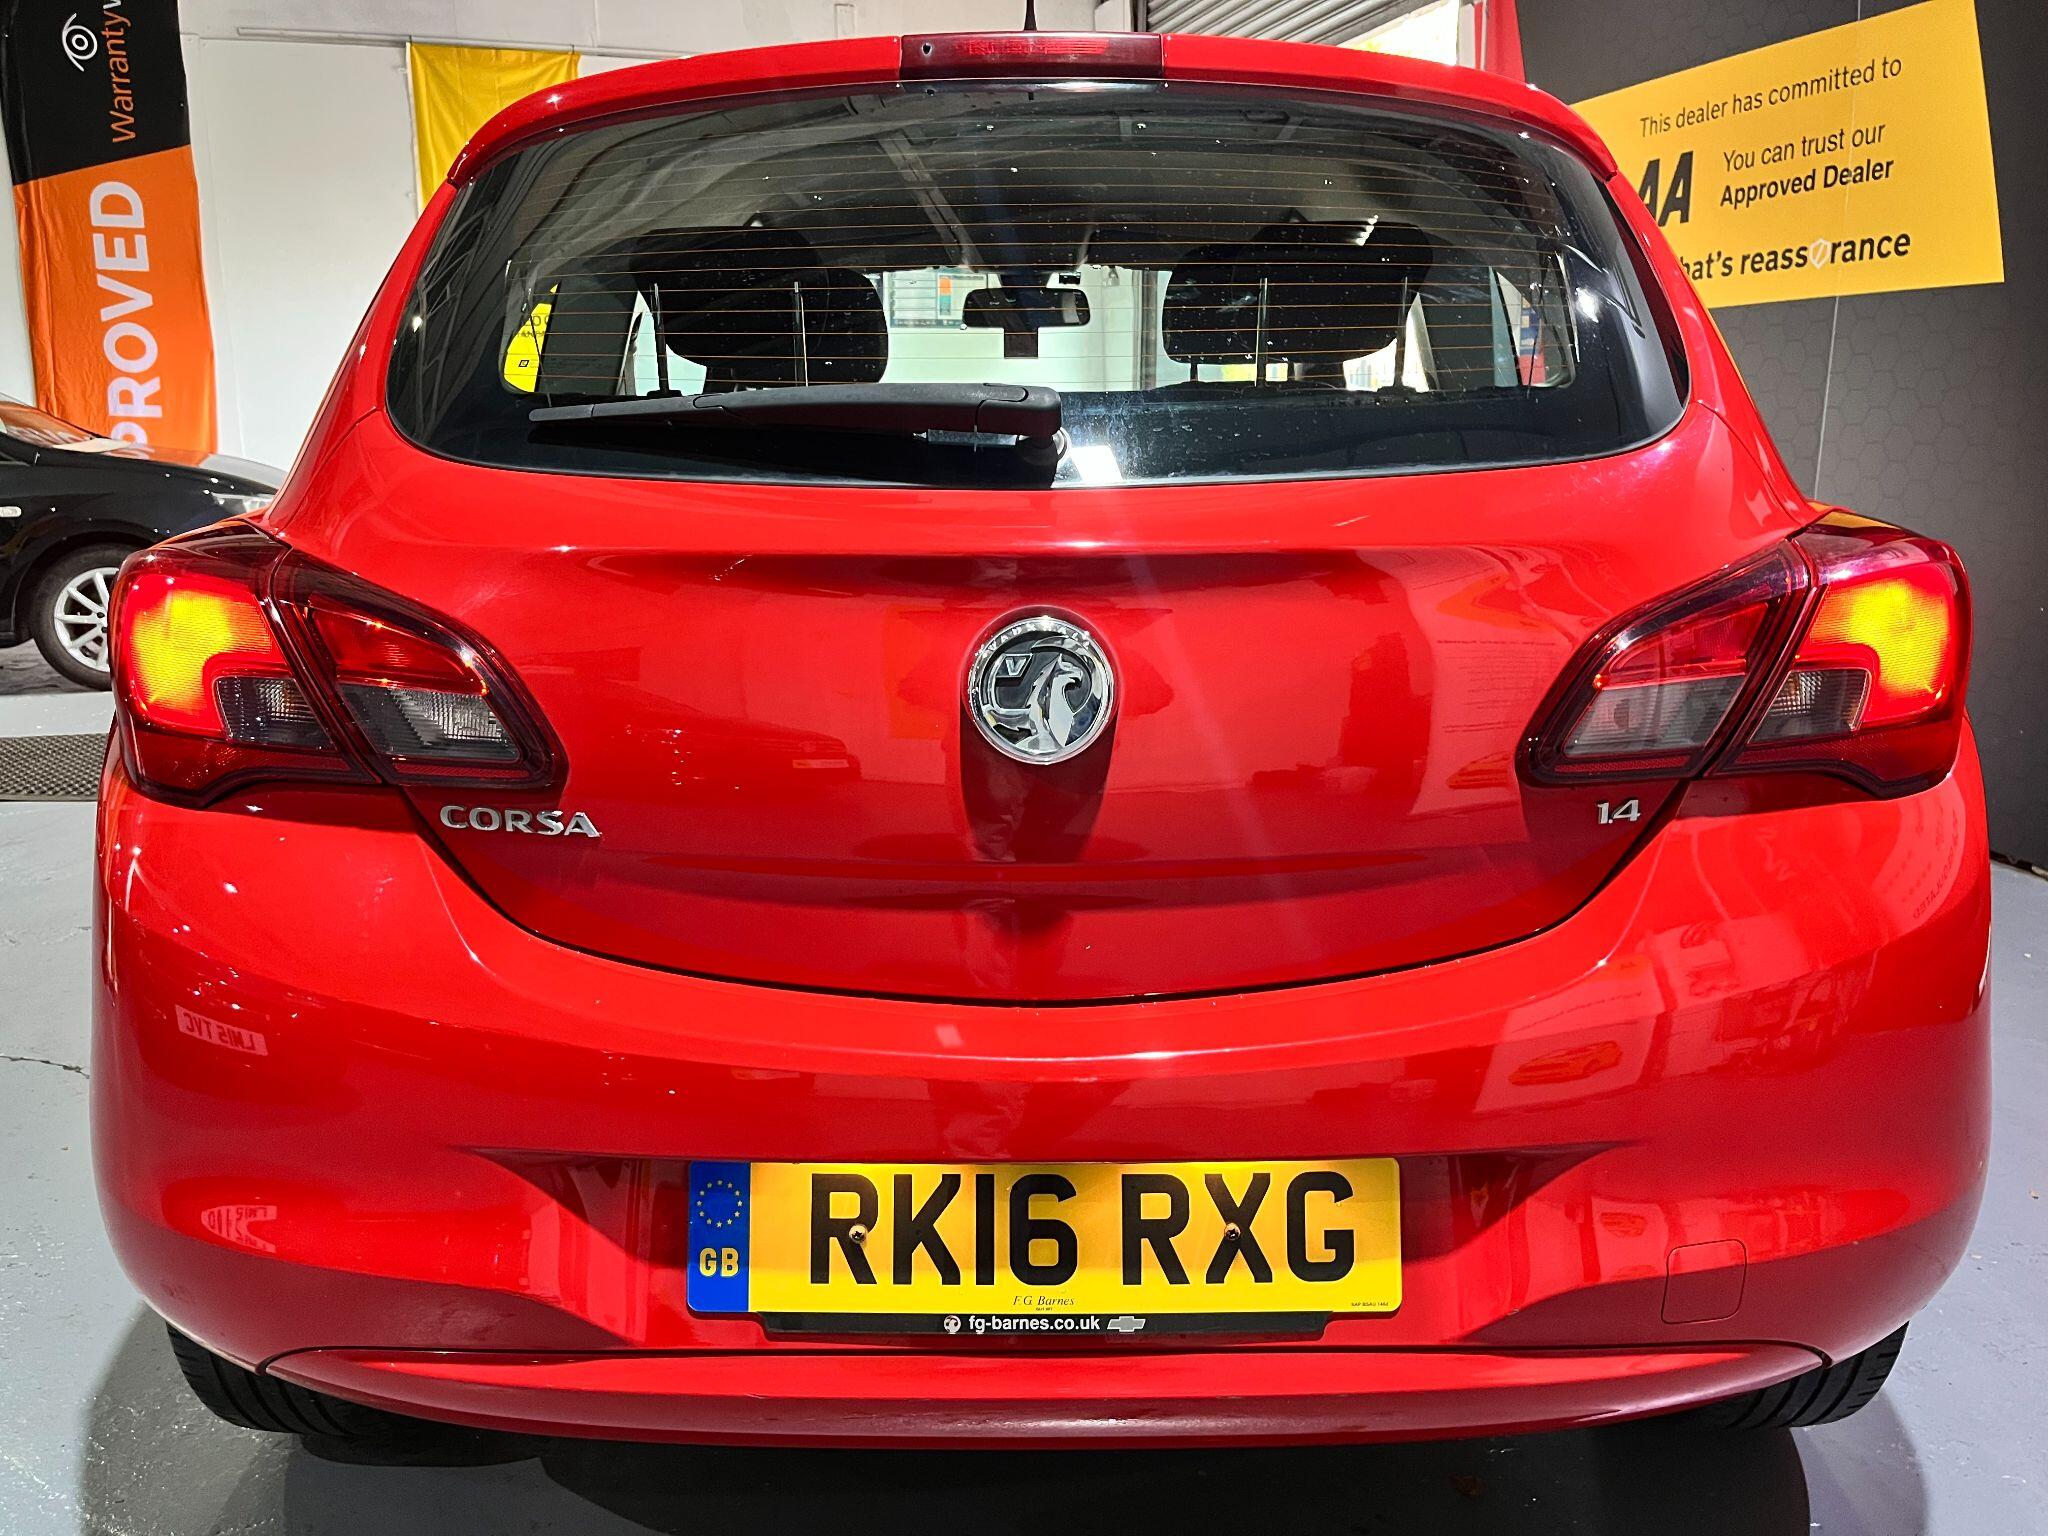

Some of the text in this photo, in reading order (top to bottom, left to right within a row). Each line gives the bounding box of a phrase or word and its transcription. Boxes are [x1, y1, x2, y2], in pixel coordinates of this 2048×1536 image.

[1639, 56, 1902, 138] This dealer has committed to
[1723, 123, 1886, 172] You can trust our
[1638, 150, 1694, 227] AA
[1720, 158, 1894, 210] Approved Dealer
[439, 805, 602, 838] CORSA
[1597, 799, 1641, 824] 1.4
[810, 1171, 1355, 1286] RK16 RXG
[699, 1247, 739, 1277] GB
[968, 1315, 1100, 1335] fg-barnes.co.uk
